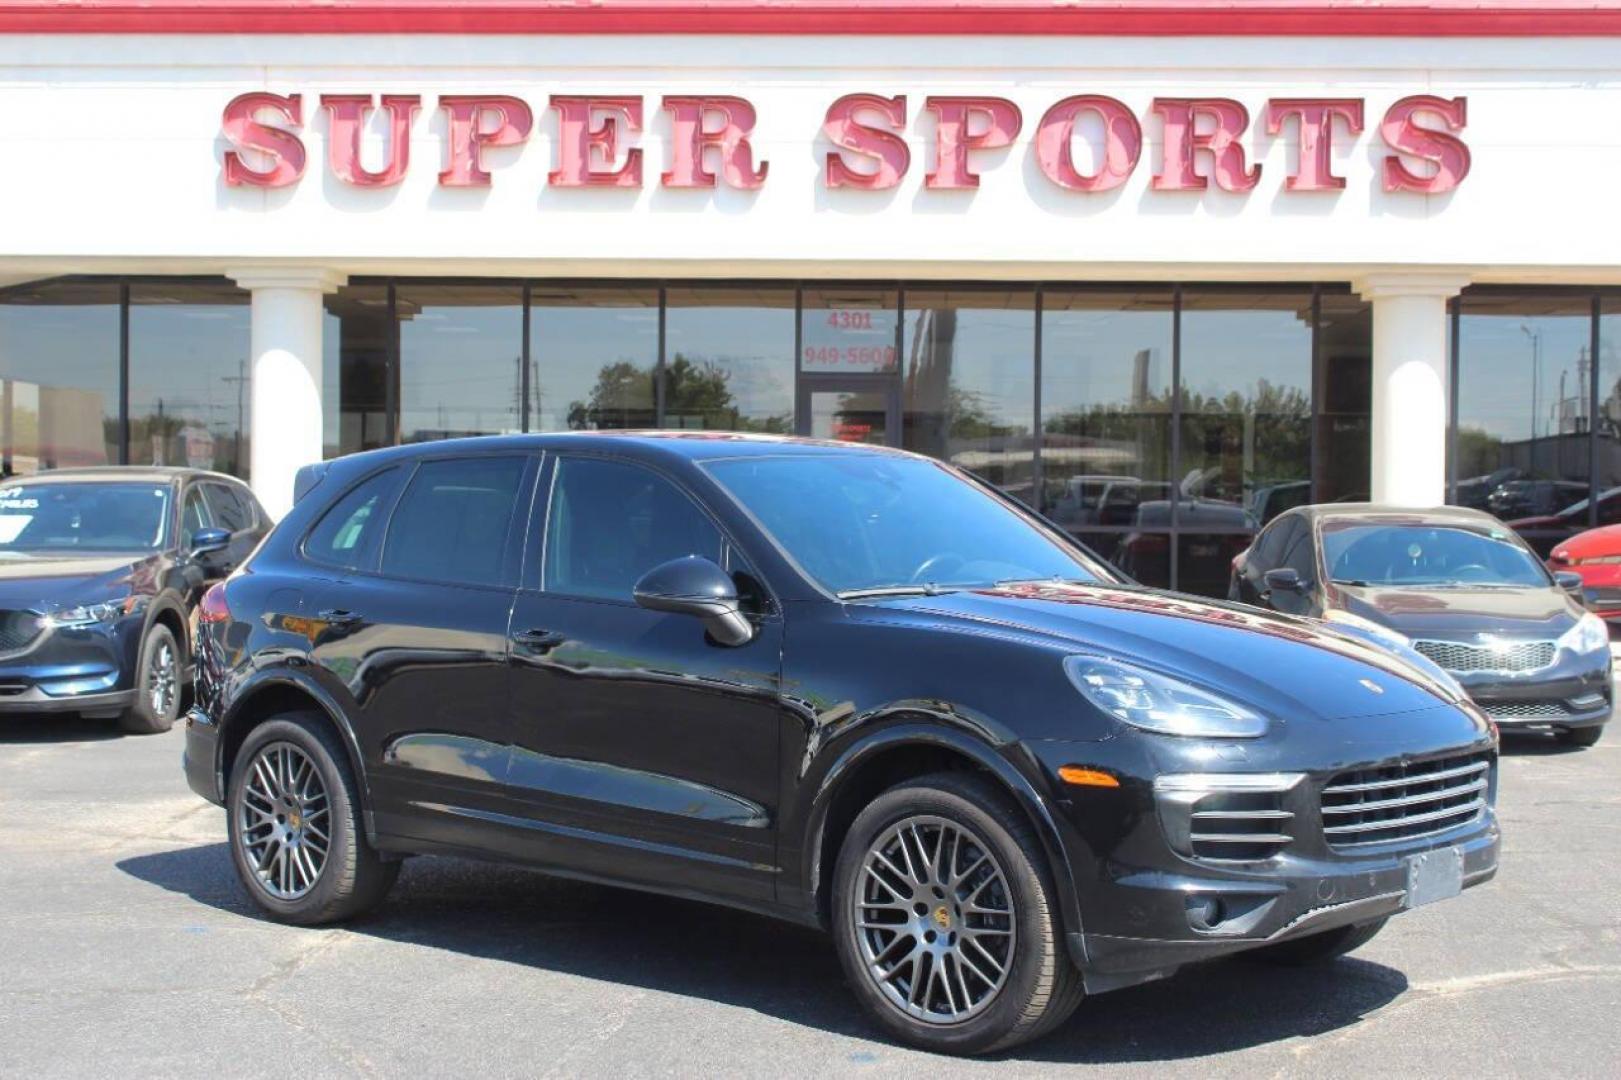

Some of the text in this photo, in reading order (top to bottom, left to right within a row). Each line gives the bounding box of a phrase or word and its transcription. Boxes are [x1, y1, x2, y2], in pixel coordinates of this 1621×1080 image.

[222, 92, 1471, 194] SUPER SPORTS
[827, 311, 872, 330] 4301
